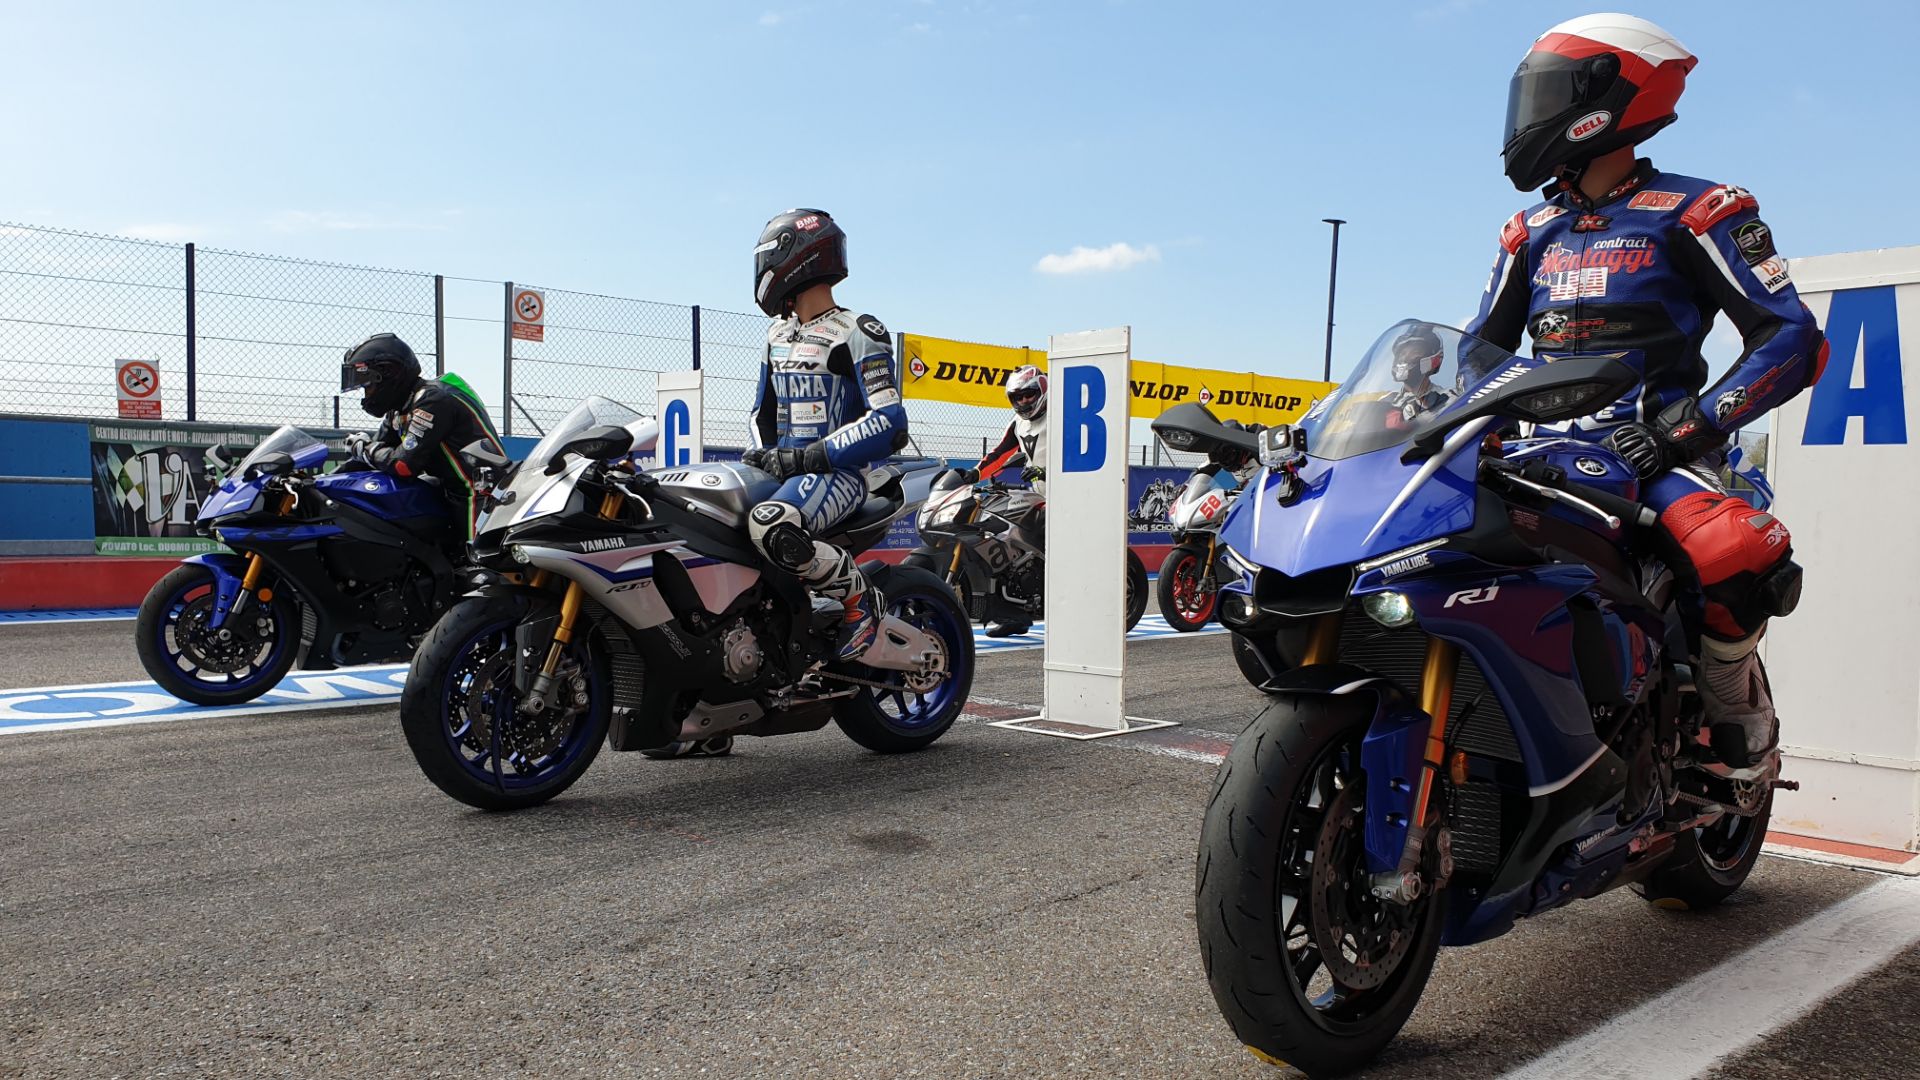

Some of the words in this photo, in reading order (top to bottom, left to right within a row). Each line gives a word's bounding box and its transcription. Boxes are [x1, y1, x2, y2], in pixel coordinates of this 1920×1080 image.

[1572, 116, 1606, 138] BELL
[795, 215, 818, 230] BMP
[1593, 237, 1649, 249] contract
[1540, 244, 1656, 273] Montaggi
[1765, 271, 1789, 289] HEVI
[1801, 285, 1908, 445] A
[1130, 380, 1189, 402] NLOP
[1470, 366, 1532, 401] YAMAHA
[1216, 390, 1301, 411] DUNLOP
[1062, 365, 1107, 473] B
[665, 399, 690, 469] C
[832, 415, 892, 450] YAMAHA
[1199, 495, 1222, 520] 58
[580, 536, 626, 552] YAMAHA
[1380, 553, 1431, 578] YAMALUBE
[1443, 586, 1500, 608] R1
